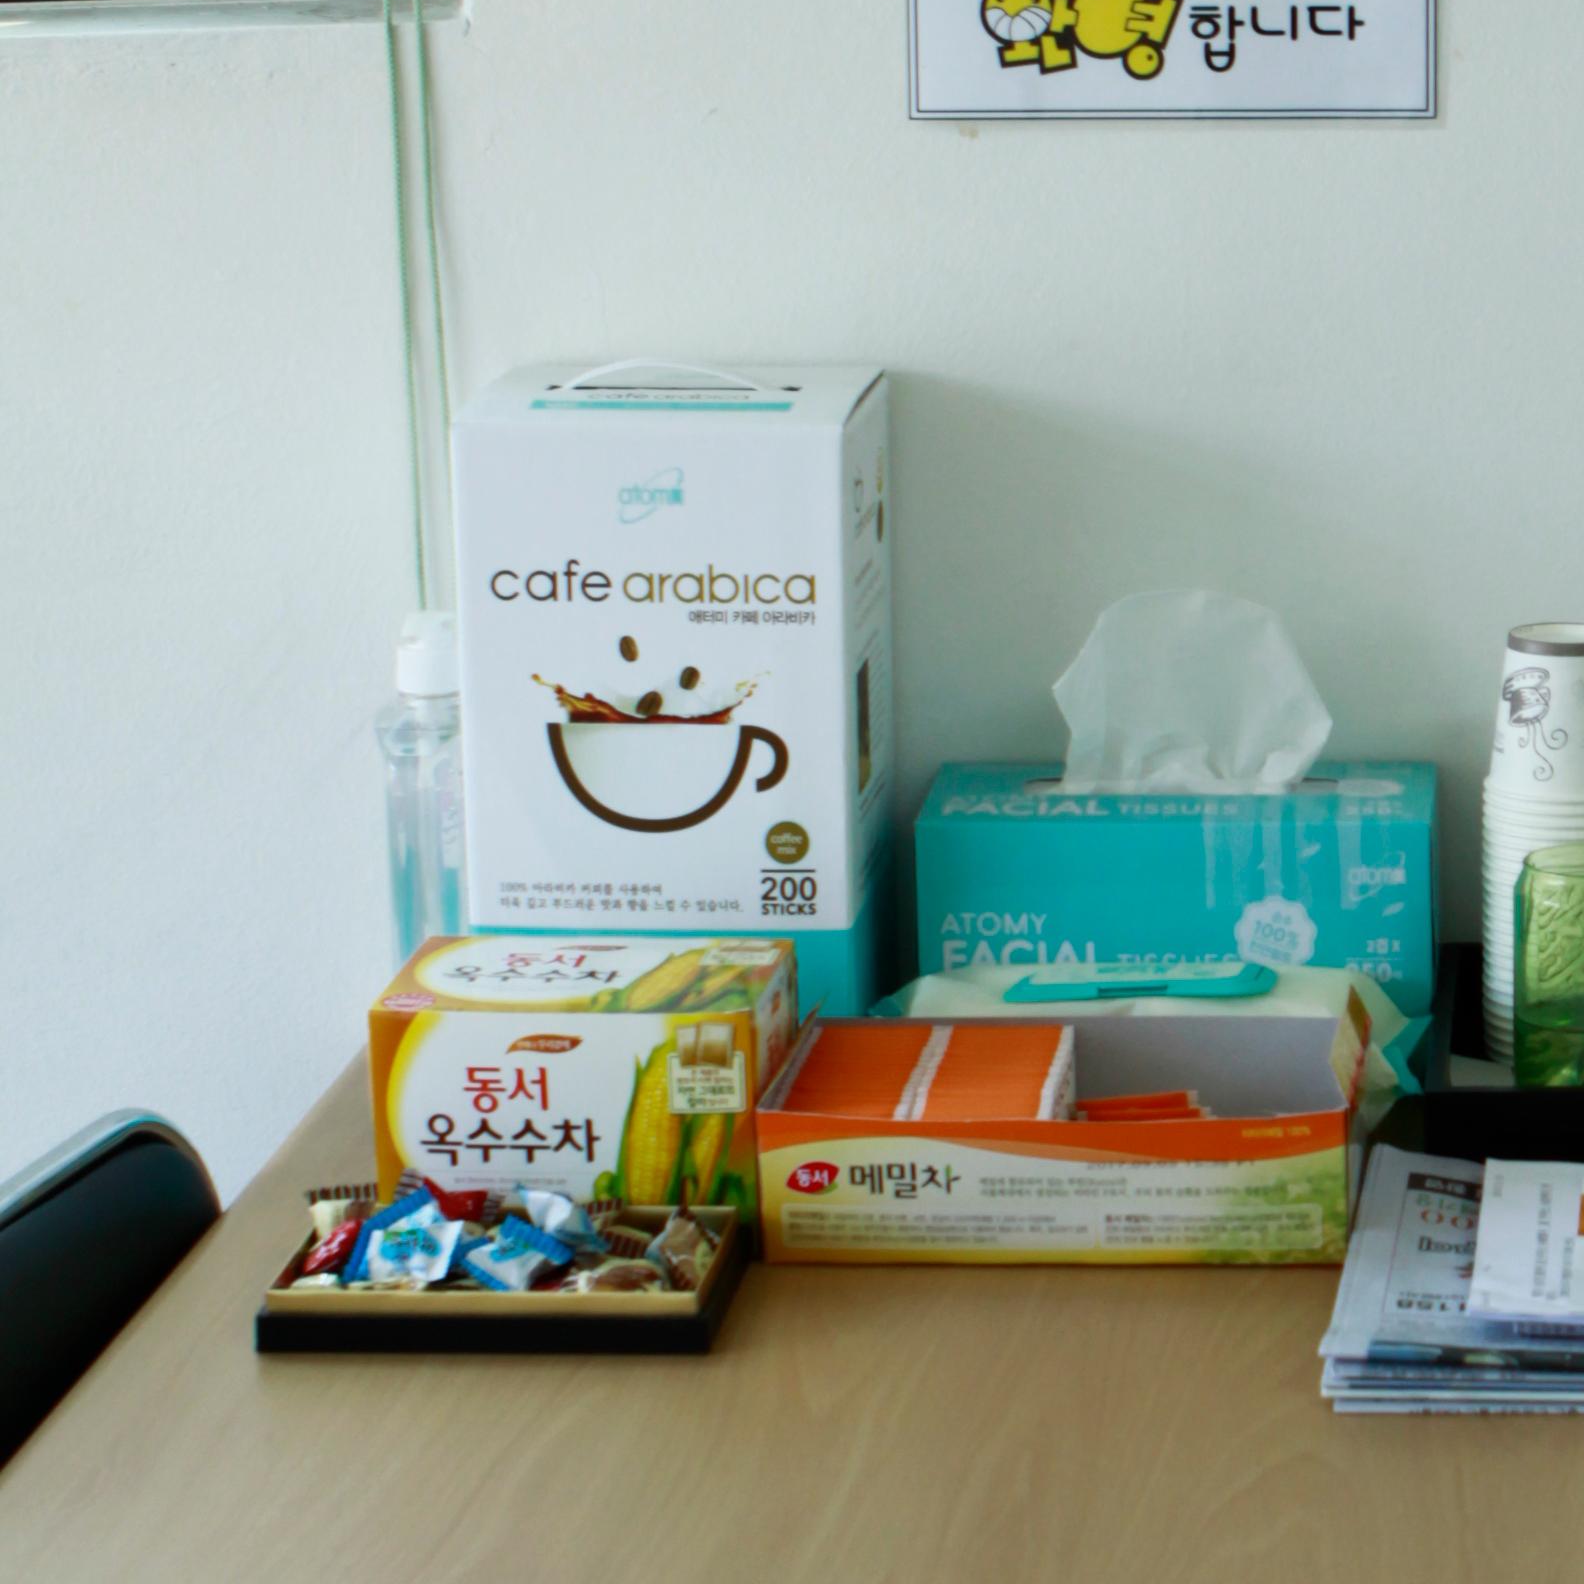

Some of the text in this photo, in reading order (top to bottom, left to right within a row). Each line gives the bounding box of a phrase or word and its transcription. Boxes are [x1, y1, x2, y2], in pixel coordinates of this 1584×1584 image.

[490, 559, 612, 602] cafe
[622, 564, 817, 604] arabica
[762, 610, 816, 624] 아라비카
[941, 799, 1111, 816] FACIAL
[770, 832, 803, 845] coffee
[776, 845, 797, 855] mix
[760, 876, 818, 902] 200
[760, 903, 818, 917] STICKS
[941, 912, 1048, 937] ATOMY
[1253, 919, 1301, 947] 100%
[504, 953, 587, 969] 동서
[442, 965, 623, 984] 옥수수차
[462, 1066, 550, 1114] 동서
[419, 1113, 603, 1168] 옥수수차
[796, 1166, 832, 1188] 동서
[848, 1161, 962, 1200] 메밀차
